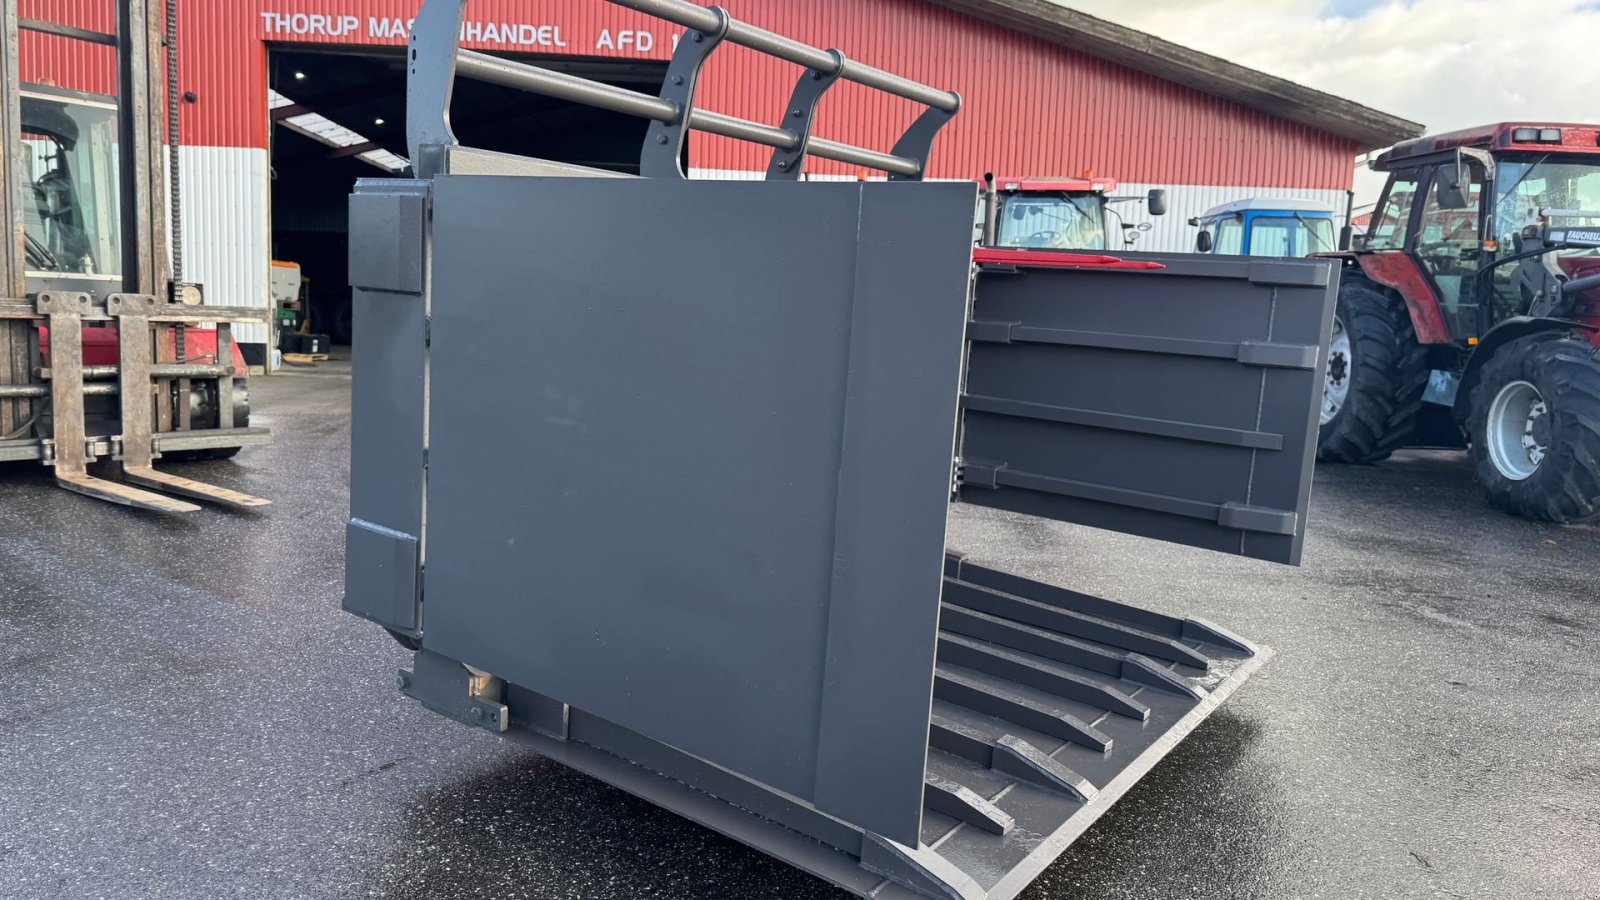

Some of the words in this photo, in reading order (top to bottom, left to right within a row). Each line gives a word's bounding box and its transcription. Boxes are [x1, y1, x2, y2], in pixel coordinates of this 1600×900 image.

[260, 11, 359, 37] THORUP
[368, 16, 567, 47] MAHANDEL
[596, 28, 654, 52] AFD
[1567, 230, 1600, 241] FAUCHEU
